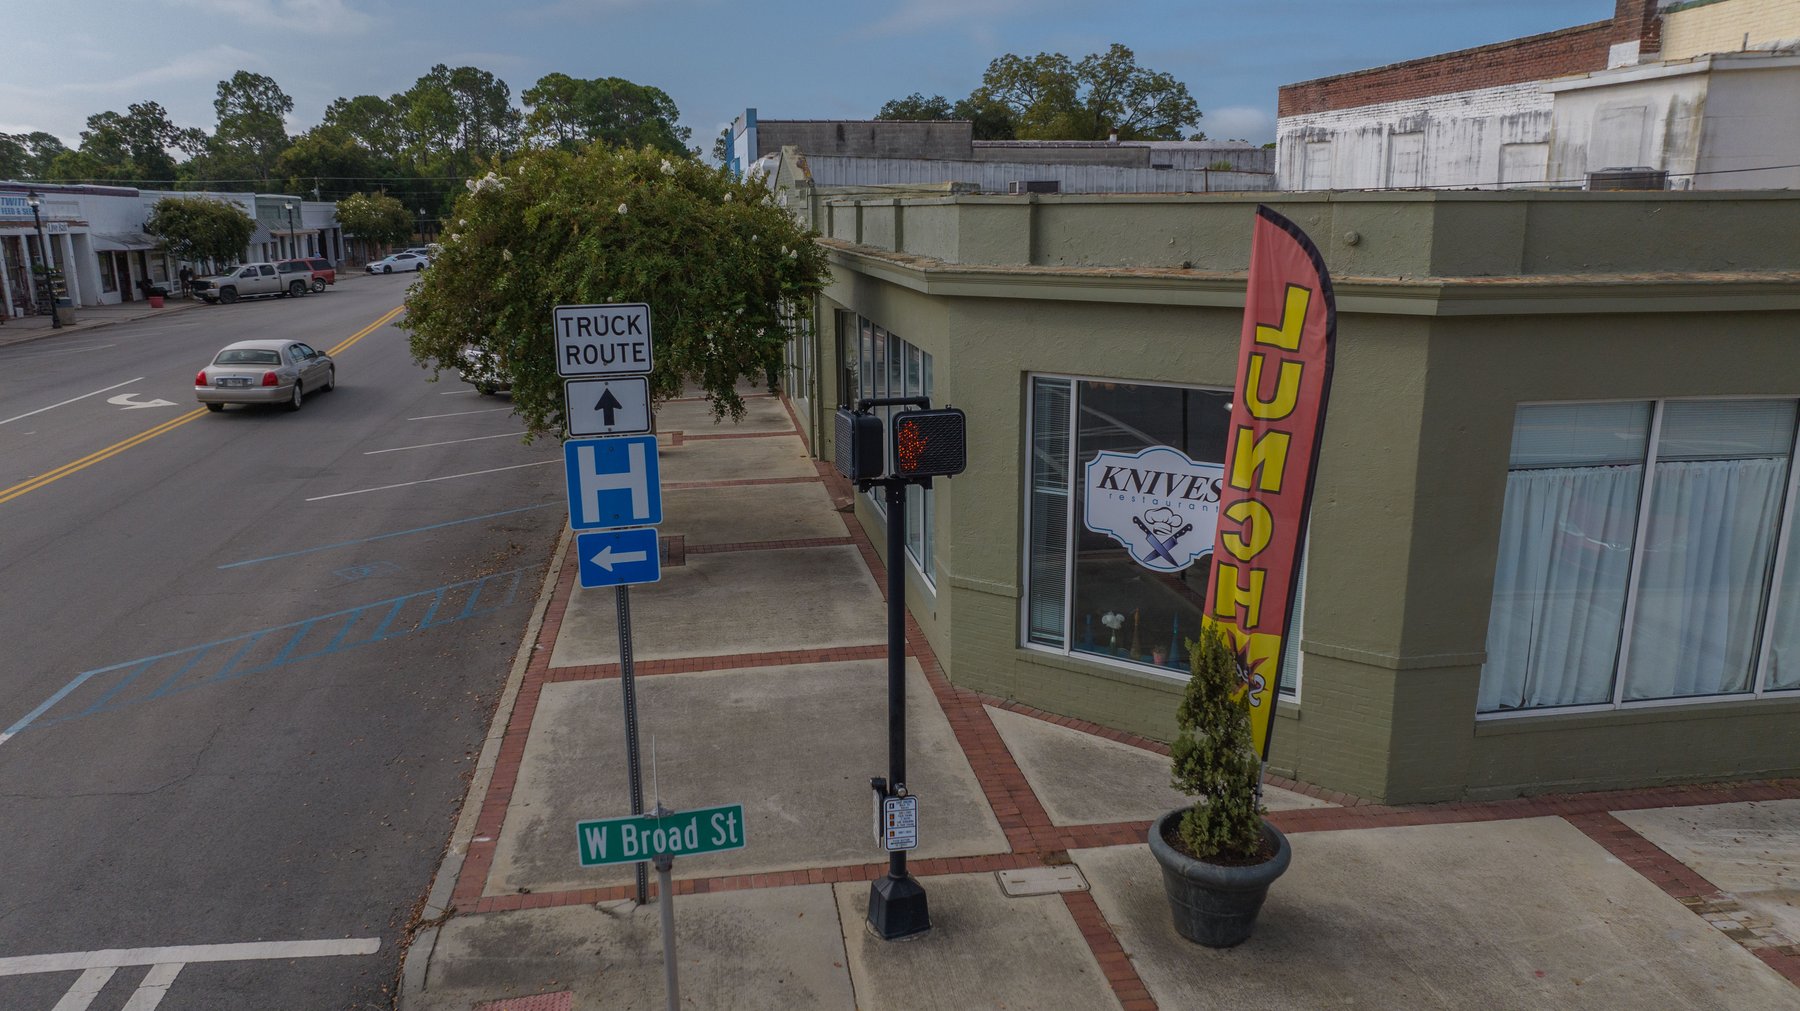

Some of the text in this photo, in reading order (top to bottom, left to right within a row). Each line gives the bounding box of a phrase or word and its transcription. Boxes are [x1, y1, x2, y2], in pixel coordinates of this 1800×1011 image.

[560, 314, 642, 338] TRUCK
[566, 342, 646, 366] ROUTE
[577, 442, 650, 524] H
[1096, 465, 1223, 503] KNIVES
[585, 811, 738, 860] W Broad St
